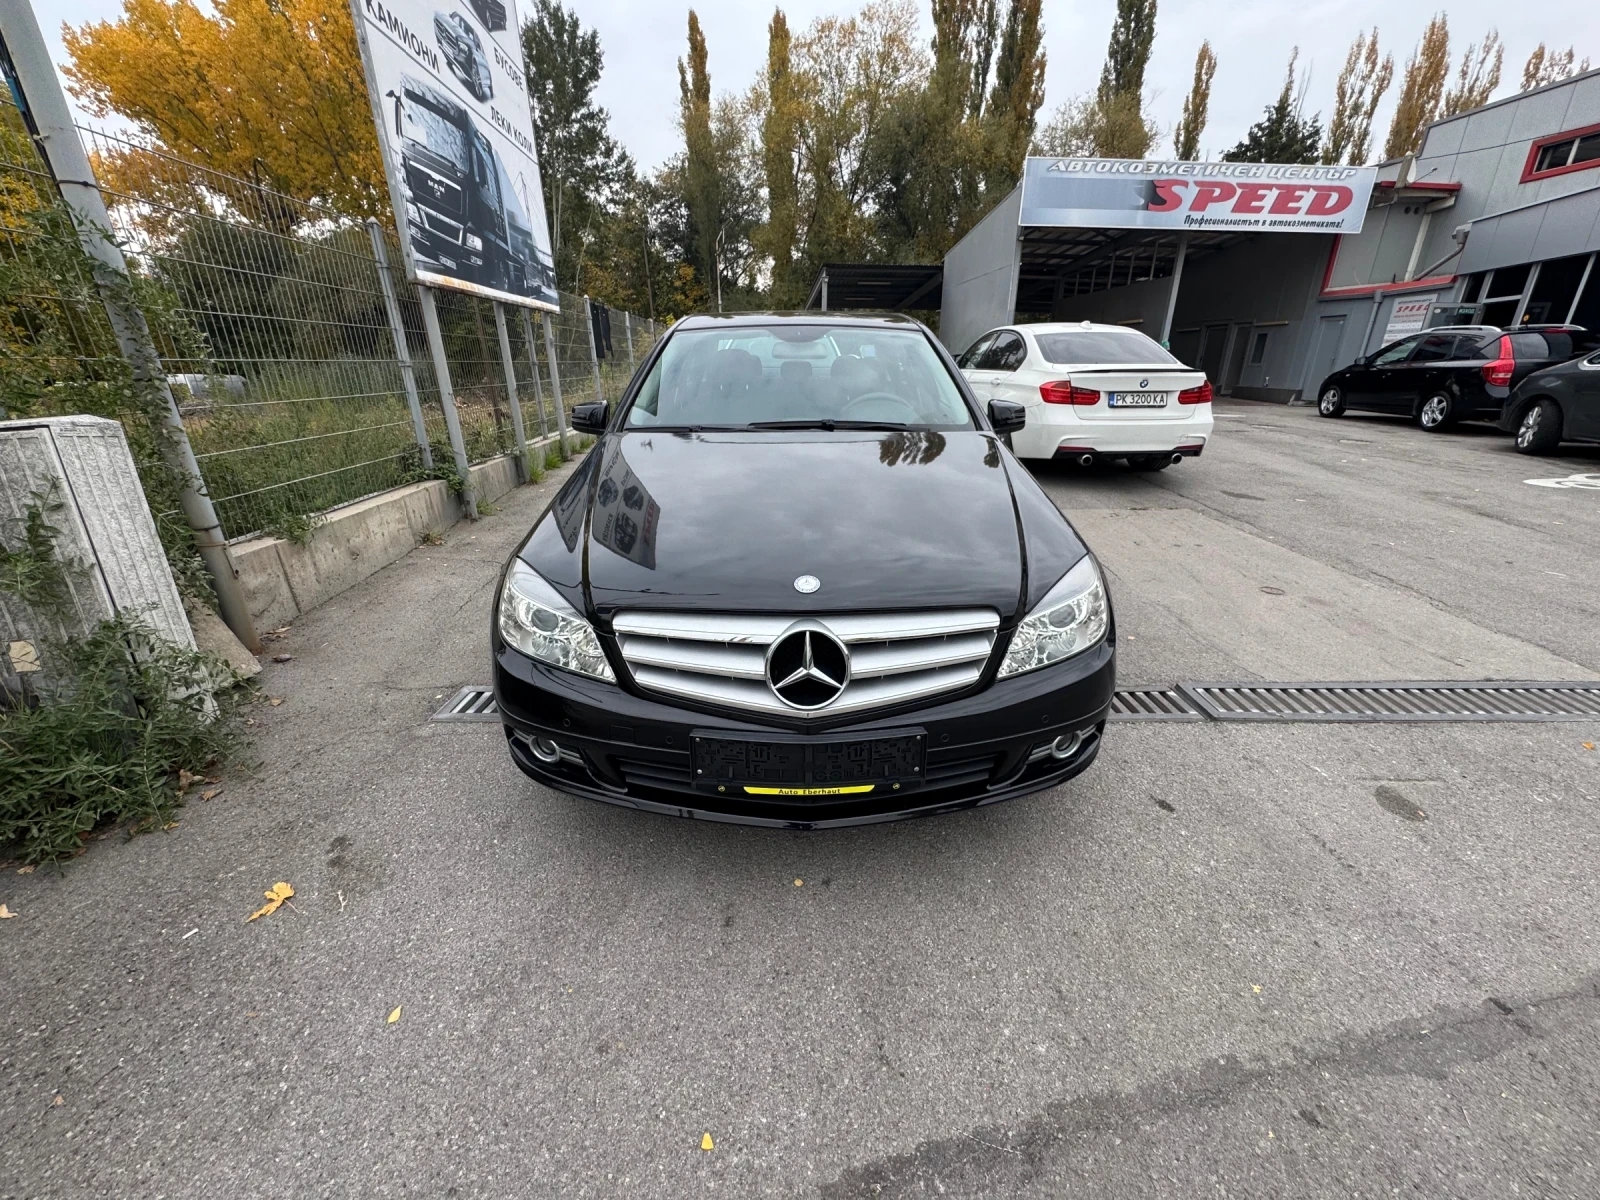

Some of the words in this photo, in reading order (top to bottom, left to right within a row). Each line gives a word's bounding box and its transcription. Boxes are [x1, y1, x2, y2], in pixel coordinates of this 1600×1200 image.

[365, 0, 440, 74] КАМИОНИ
[493, 46, 524, 92] БУСОВЕ
[490, 105, 512, 137] ЛЕКИ
[512, 126, 533, 156] КОЛИ
[1048, 160, 1265, 177] АВТОКОЗМЕТИЧЕН
[1268, 166, 1357, 180] ЦЕНТЪР
[1147, 179, 1354, 216] SPEED
[1184, 214, 1259, 228] Професионалистът
[1261, 218, 1266, 227] в
[1268, 218, 1344, 229] автокозметиката!
[1115, 394, 1128, 405] PK
[1129, 394, 1152, 405] 3200
[1152, 394, 1165, 405] KA
